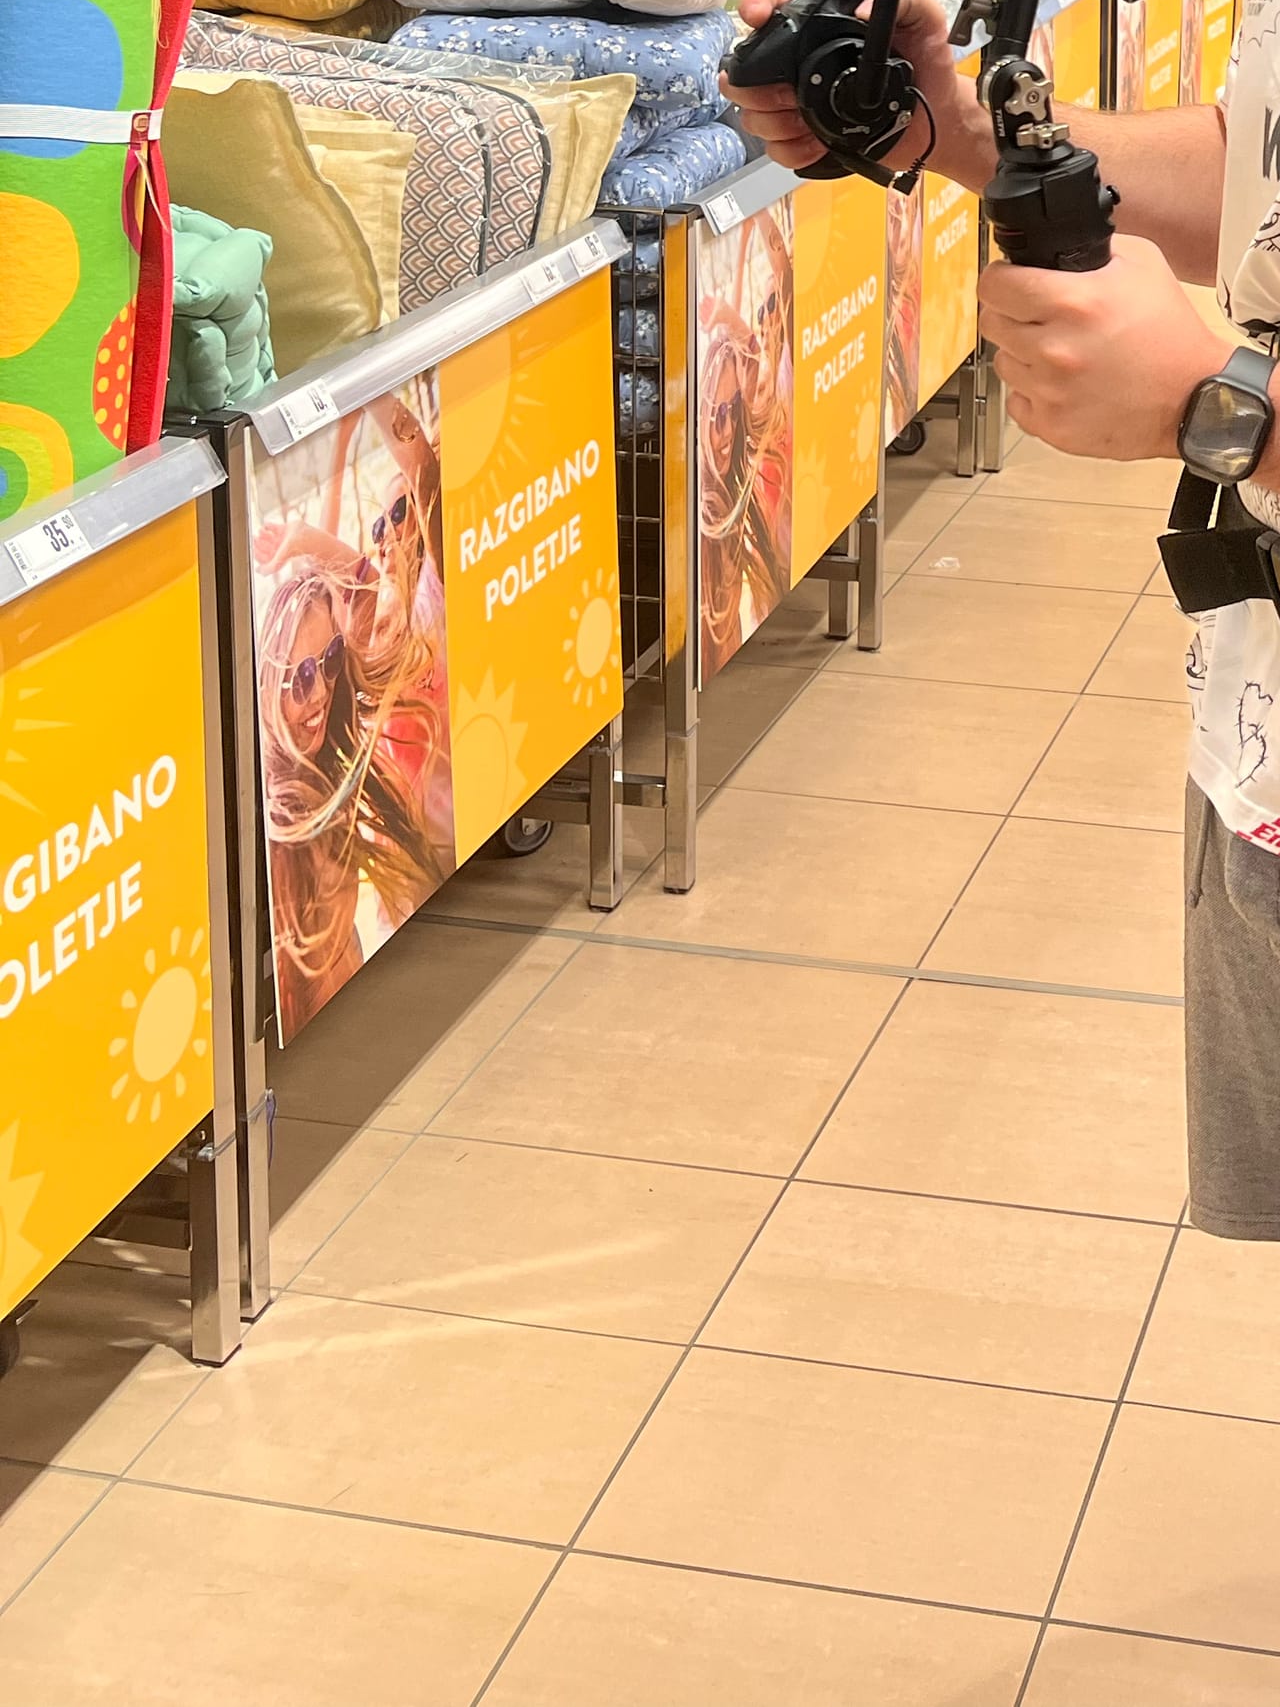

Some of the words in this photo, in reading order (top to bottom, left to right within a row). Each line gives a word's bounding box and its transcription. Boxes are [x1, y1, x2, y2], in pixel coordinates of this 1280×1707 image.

[934, 209, 969, 263] POLETJE
[802, 275, 877, 360] RAZGIBANO
[813, 331, 865, 404] POLETJE
[459, 439, 600, 574] RAZGIBANO
[485, 513, 583, 622] POLETJE
[0, 755, 177, 914] GIBANO
